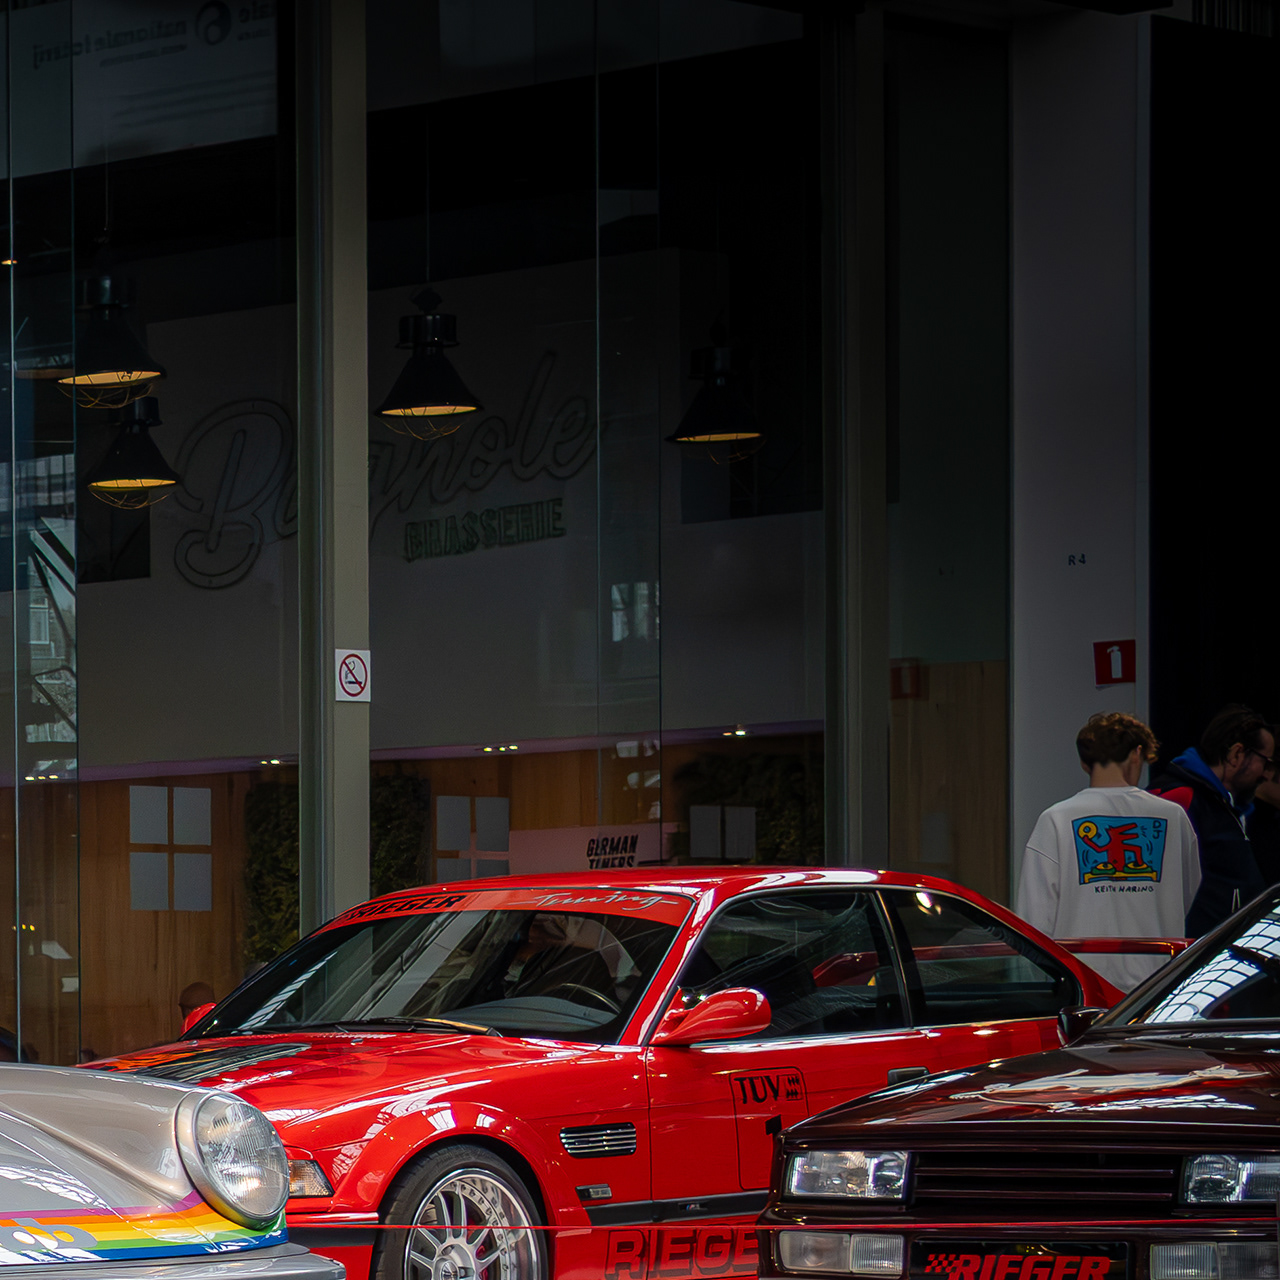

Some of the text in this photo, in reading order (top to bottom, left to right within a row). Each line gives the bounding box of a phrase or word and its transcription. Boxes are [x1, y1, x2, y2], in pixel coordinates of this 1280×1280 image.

[403, 498, 567, 563] BRASSERIE
[586, 833, 639, 858] GERMAN
[518, 890, 672, 911] Tuning
